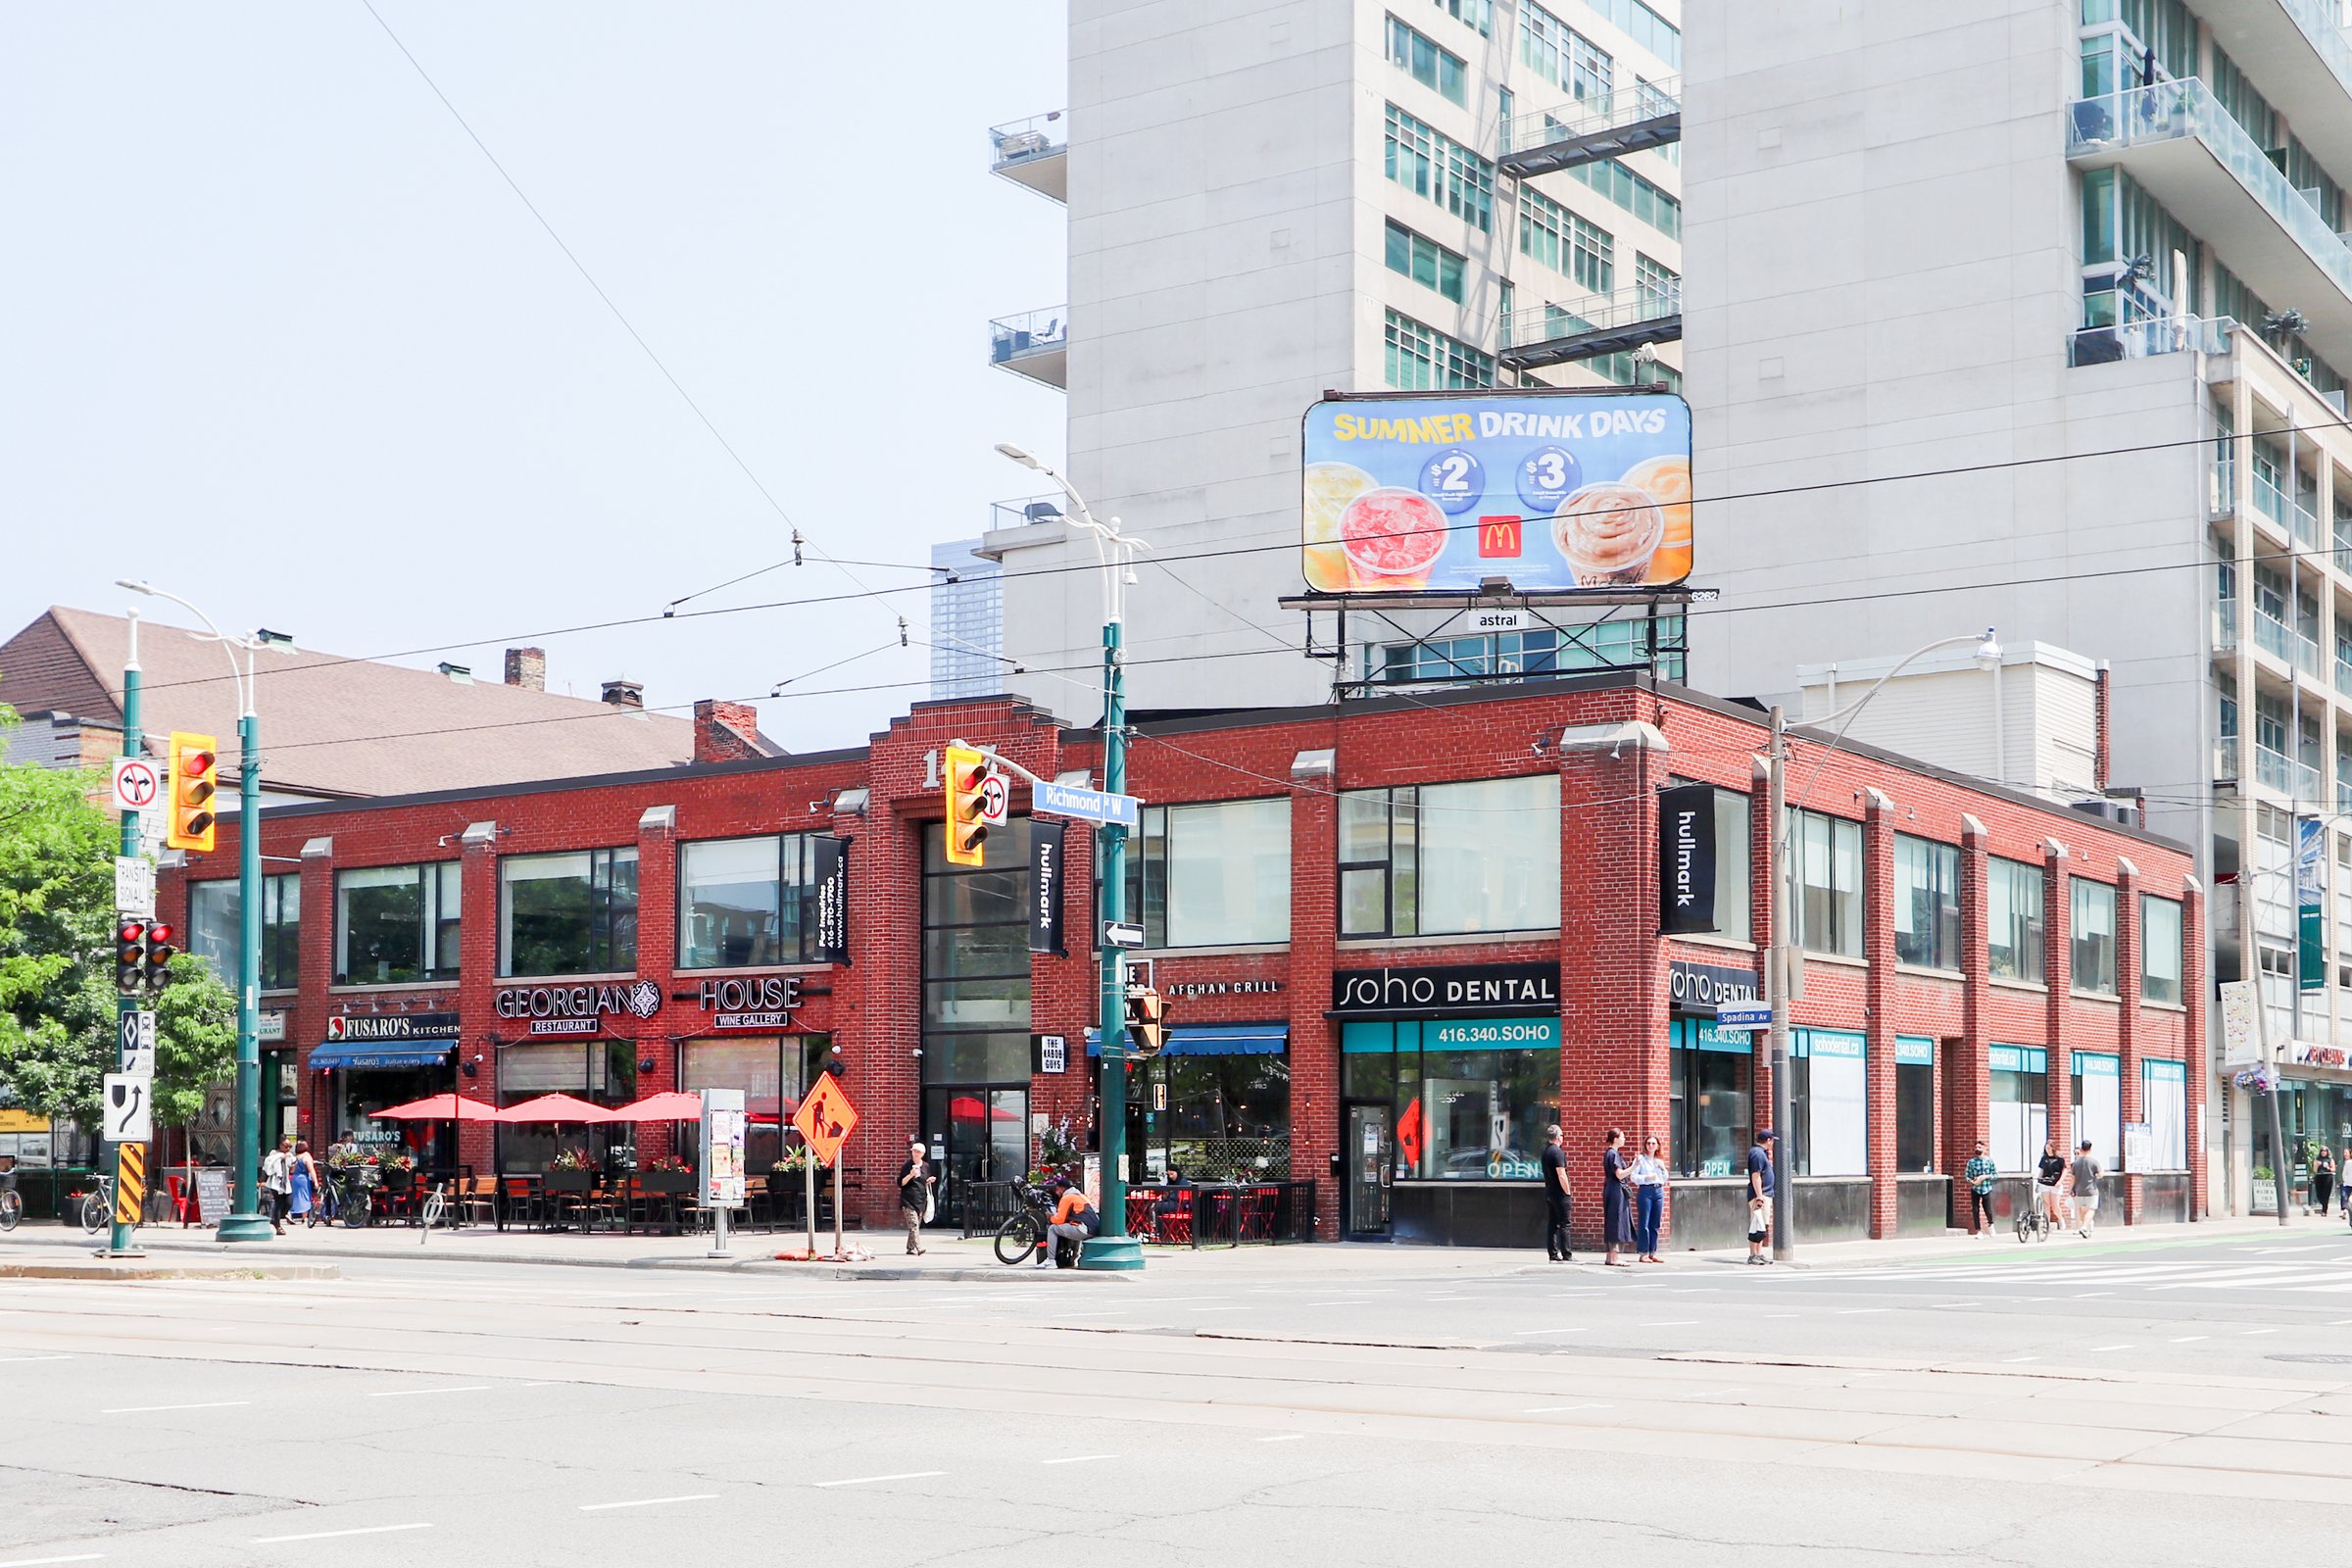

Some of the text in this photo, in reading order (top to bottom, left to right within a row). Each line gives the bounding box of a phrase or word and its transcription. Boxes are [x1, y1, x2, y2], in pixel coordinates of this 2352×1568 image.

[1333, 409, 1668, 444] SUMMER DRINK DAYS
[1691, 591, 1718, 602] 6262
[1480, 614, 1518, 626] astral
[1046, 786, 1101, 813] Richmond
[1111, 797, 1122, 816] W
[1678, 811, 1696, 906] hullmark
[119, 864, 146, 883] TRANSIT
[120, 886, 144, 904] SIGNAL
[1040, 843, 1054, 929] hullmark
[1168, 981, 1278, 996] AFGHAN GRILL
[1340, 967, 1555, 1005] soho DENTAL
[496, 978, 802, 1018] GEORGIAN HOUSE
[535, 1014, 782, 1032] RESTAURANT WINE GALLERY
[1722, 1012, 1755, 1023] Spadina
[346, 1017, 461, 1038] FUSARO'S KITCHEN
[1439, 1025, 1550, 1043] 416.340.SOHO
[1048, 1039, 1058, 1049] THE
[1815, 1036, 1860, 1055] sohodental.ca
[1044, 1050, 1062, 1059] KABOB
[1045, 1059, 1061, 1069] GUYS
[1488, 1162, 1539, 1178] OPEN
[1704, 1161, 1730, 1176] OPEN
